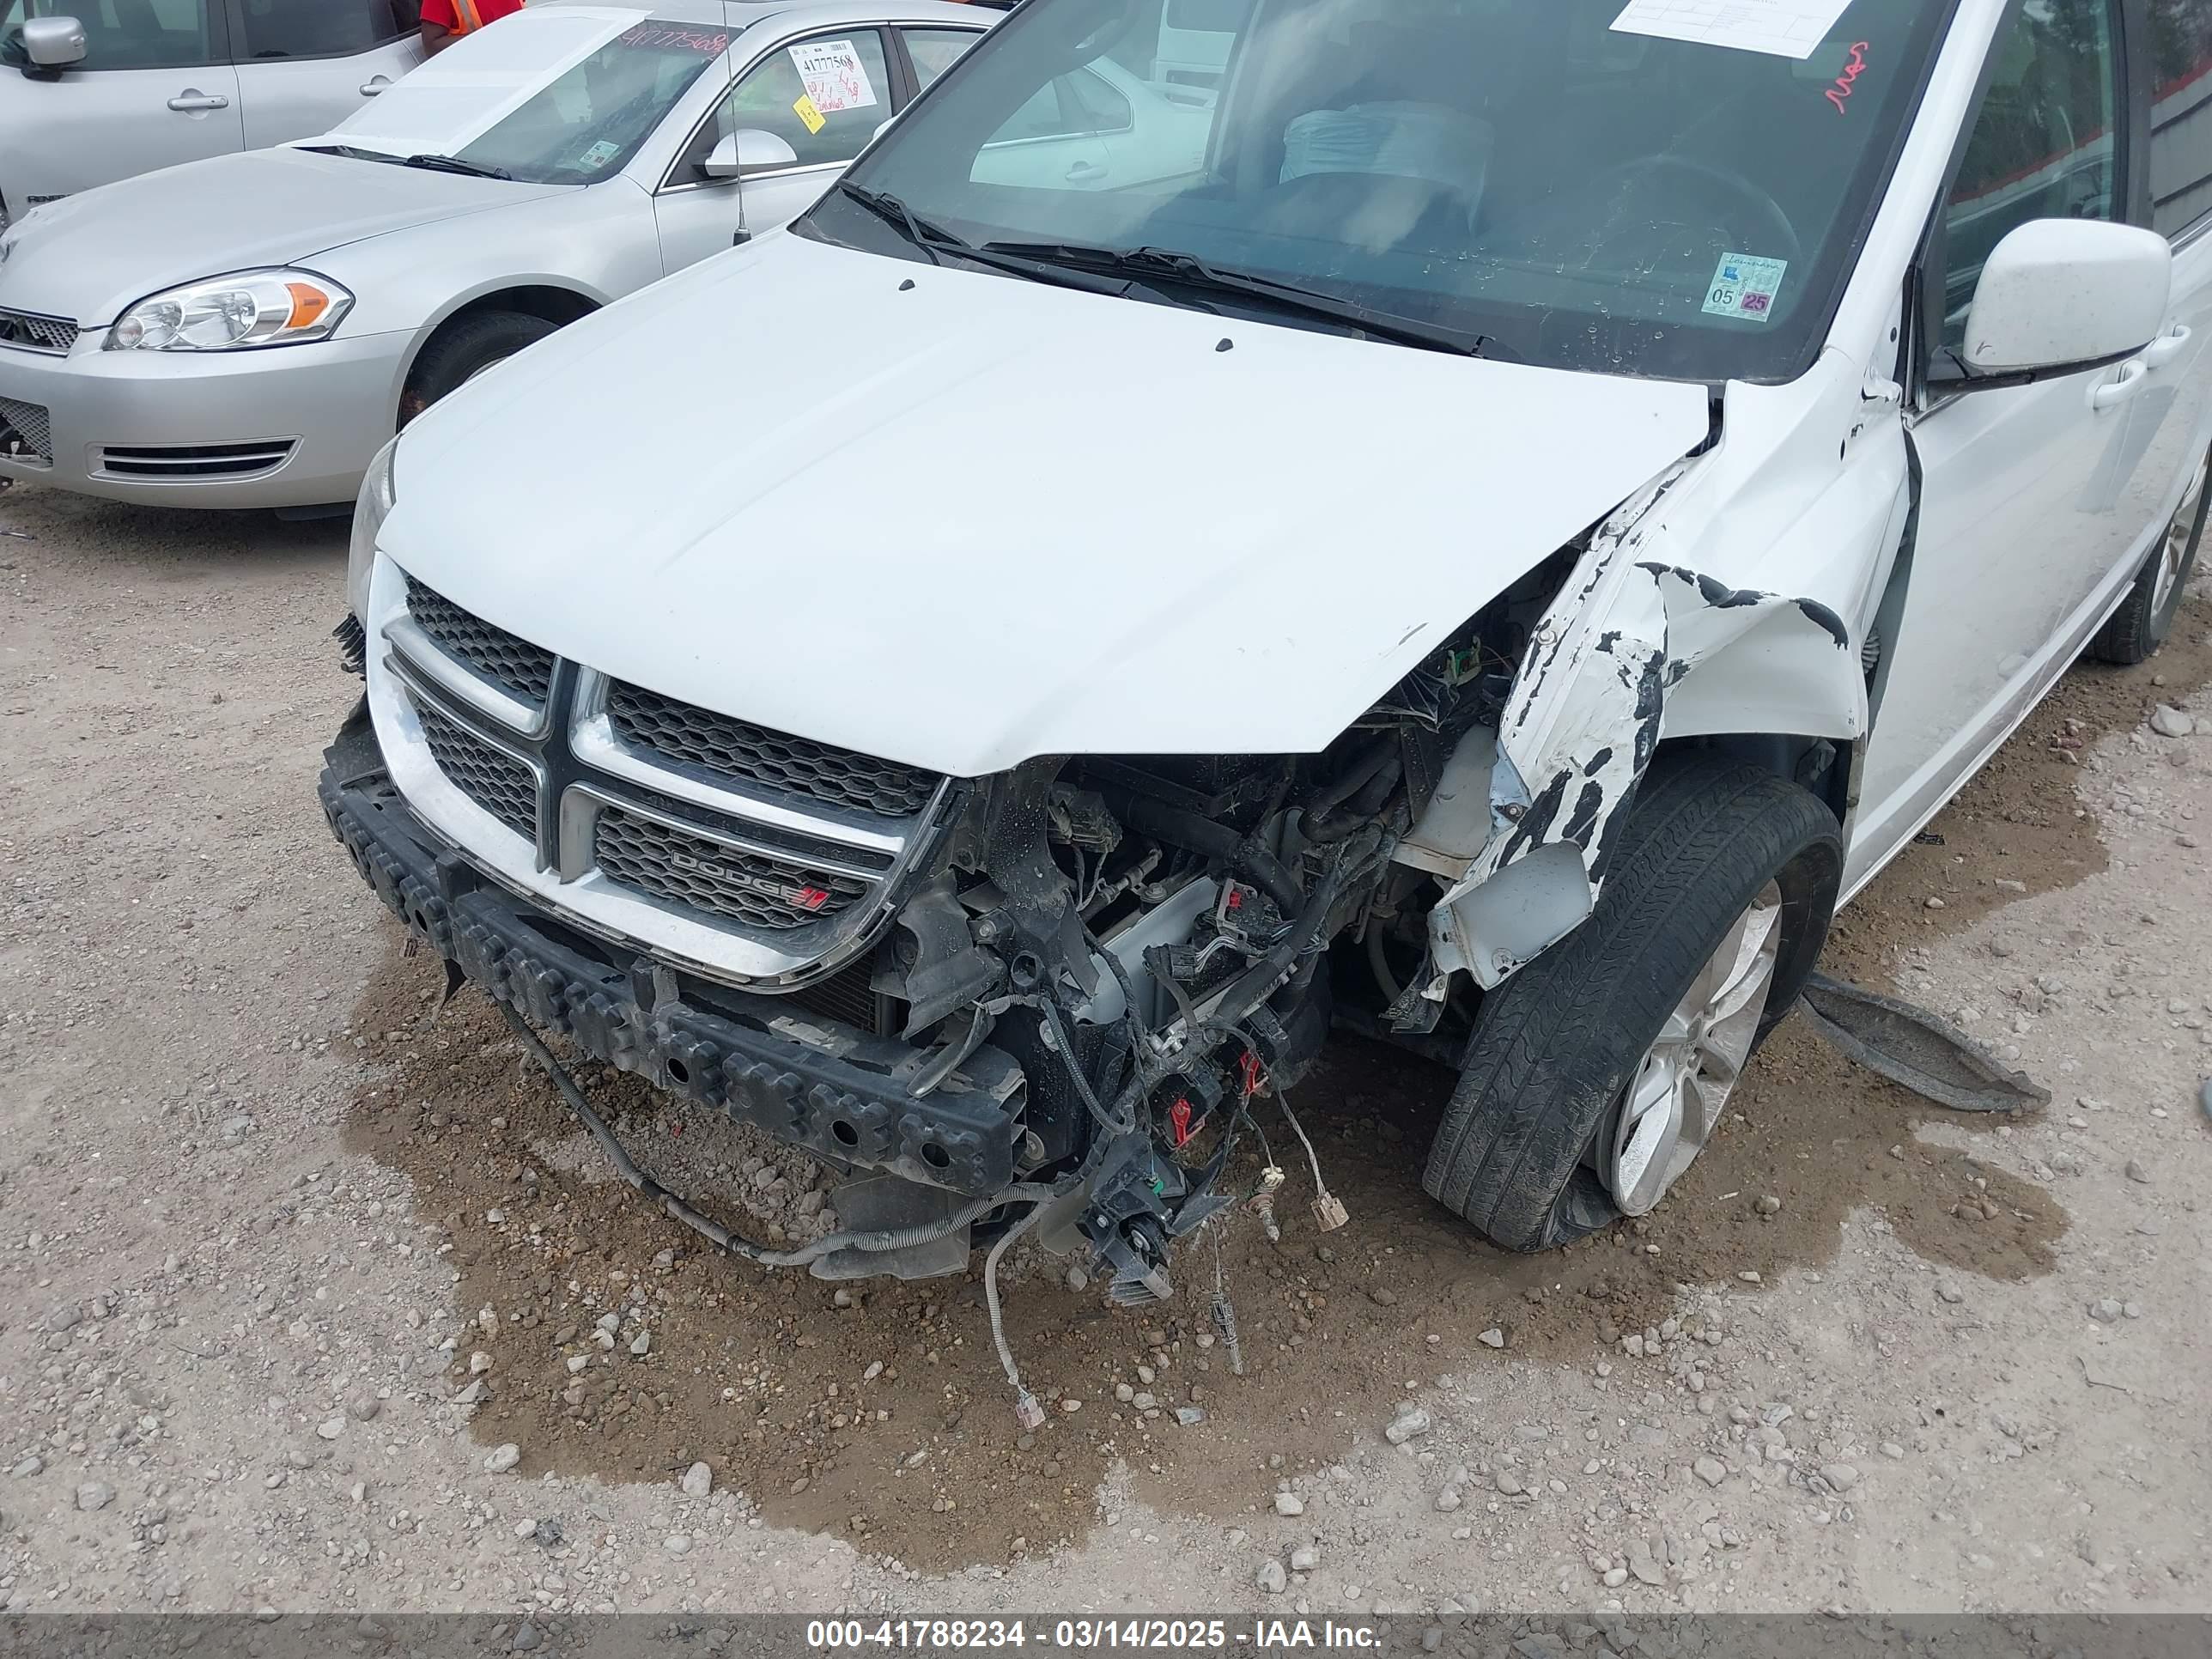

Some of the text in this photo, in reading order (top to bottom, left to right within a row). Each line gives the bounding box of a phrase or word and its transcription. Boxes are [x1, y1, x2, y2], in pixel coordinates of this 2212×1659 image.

[803, 53, 854, 72] 41777568
[1712, 289, 1734, 304] 05
[1744, 294, 1767, 309] 25
[672, 849, 806, 904] DODGE
